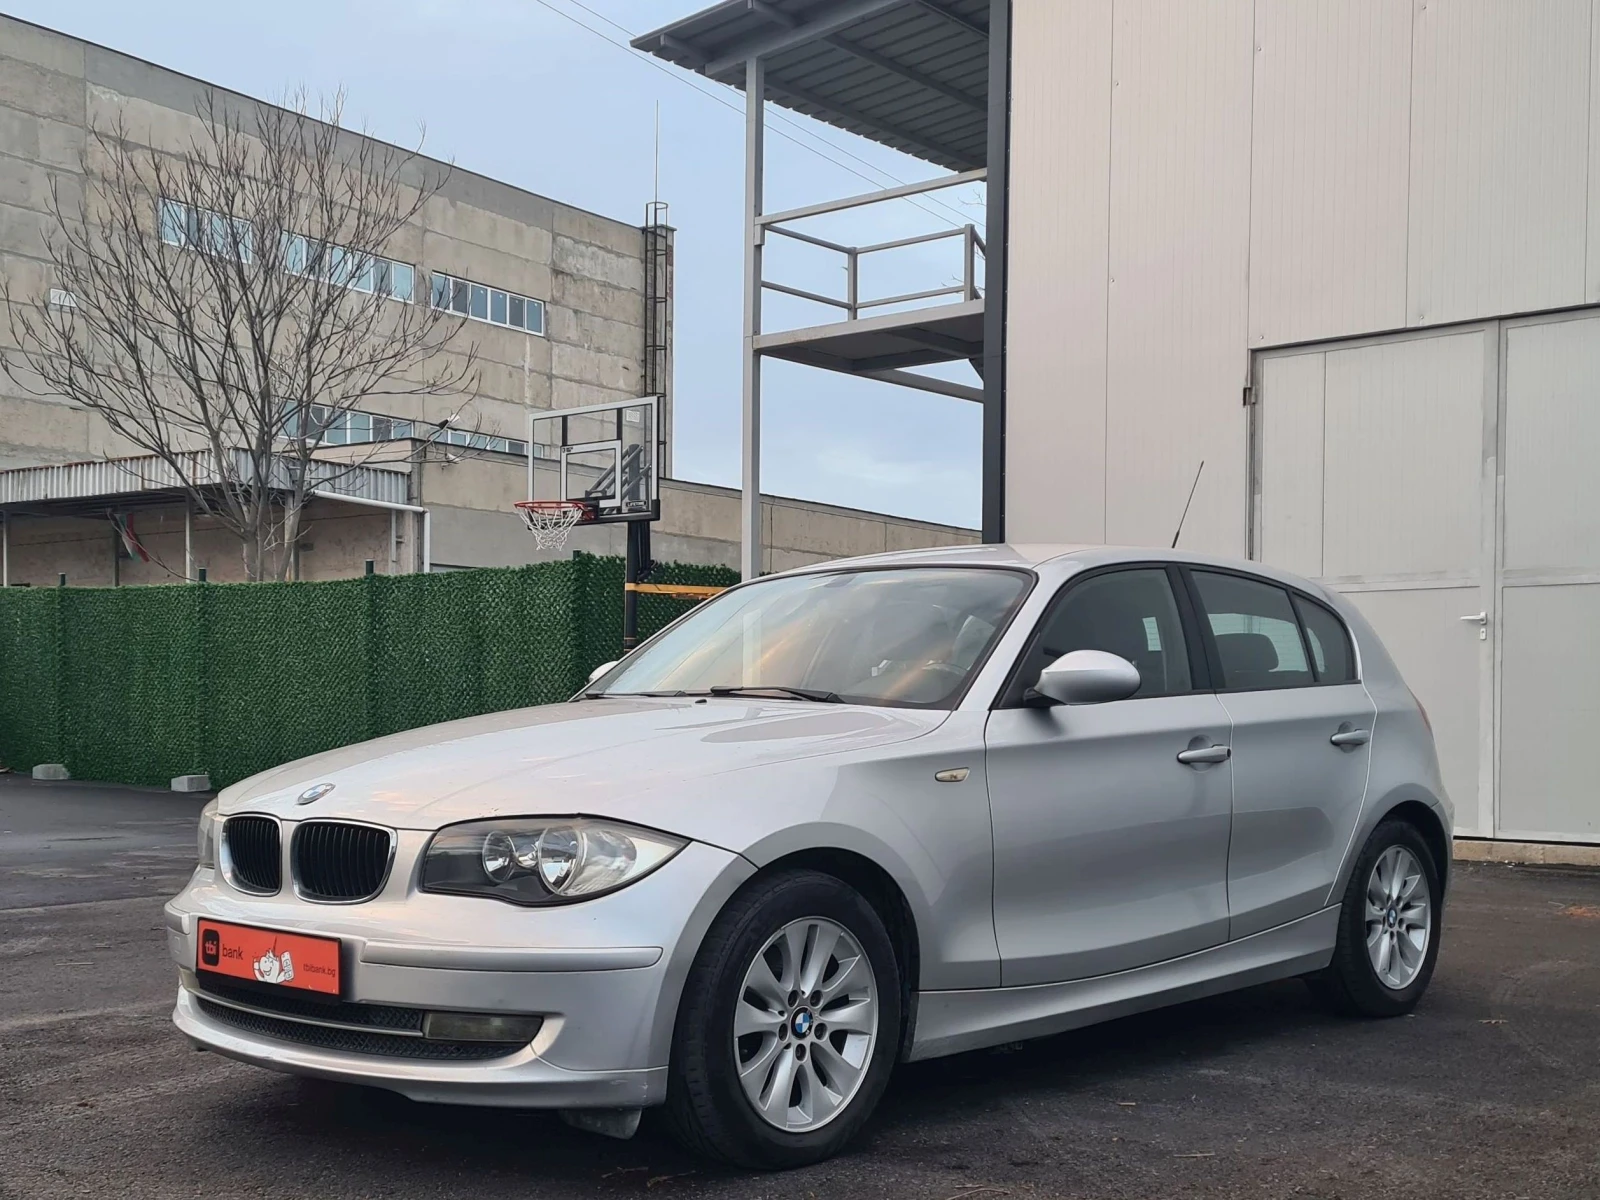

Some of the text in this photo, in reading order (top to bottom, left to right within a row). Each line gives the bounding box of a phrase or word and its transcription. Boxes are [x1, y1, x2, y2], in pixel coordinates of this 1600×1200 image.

[205, 940, 243, 960] tbi bank
[303, 964, 336, 977] tbibank.bg
